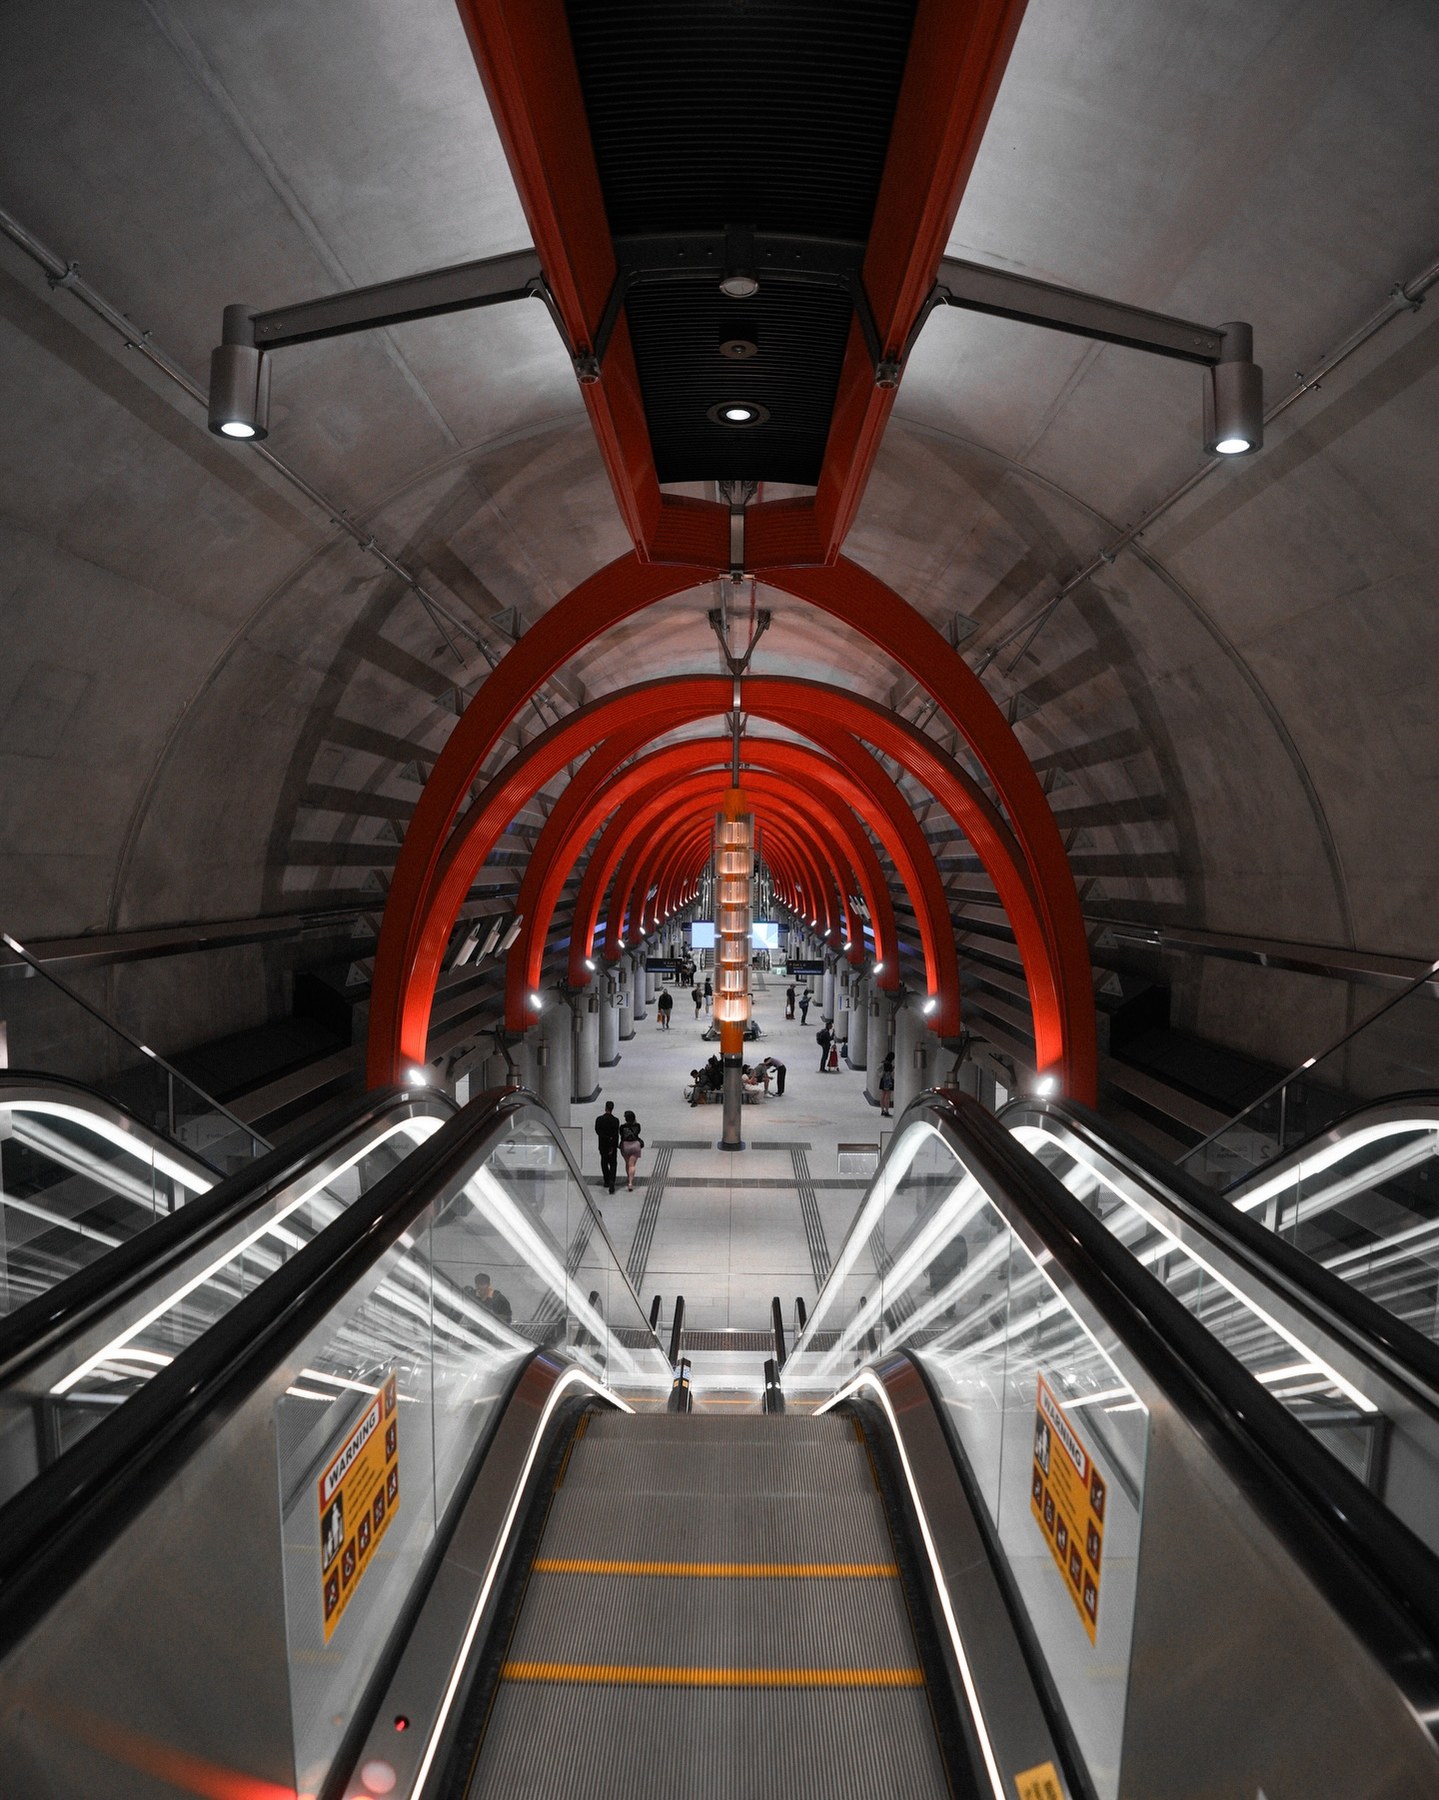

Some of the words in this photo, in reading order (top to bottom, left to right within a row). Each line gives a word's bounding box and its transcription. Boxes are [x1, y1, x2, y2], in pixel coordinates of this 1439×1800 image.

[616, 994, 624, 1006] 2
[845, 997, 851, 1009] 1
[506, 1139, 516, 1154] 2
[1044, 1395, 1082, 1467] WARNING
[329, 1412, 376, 1488] WARNING
